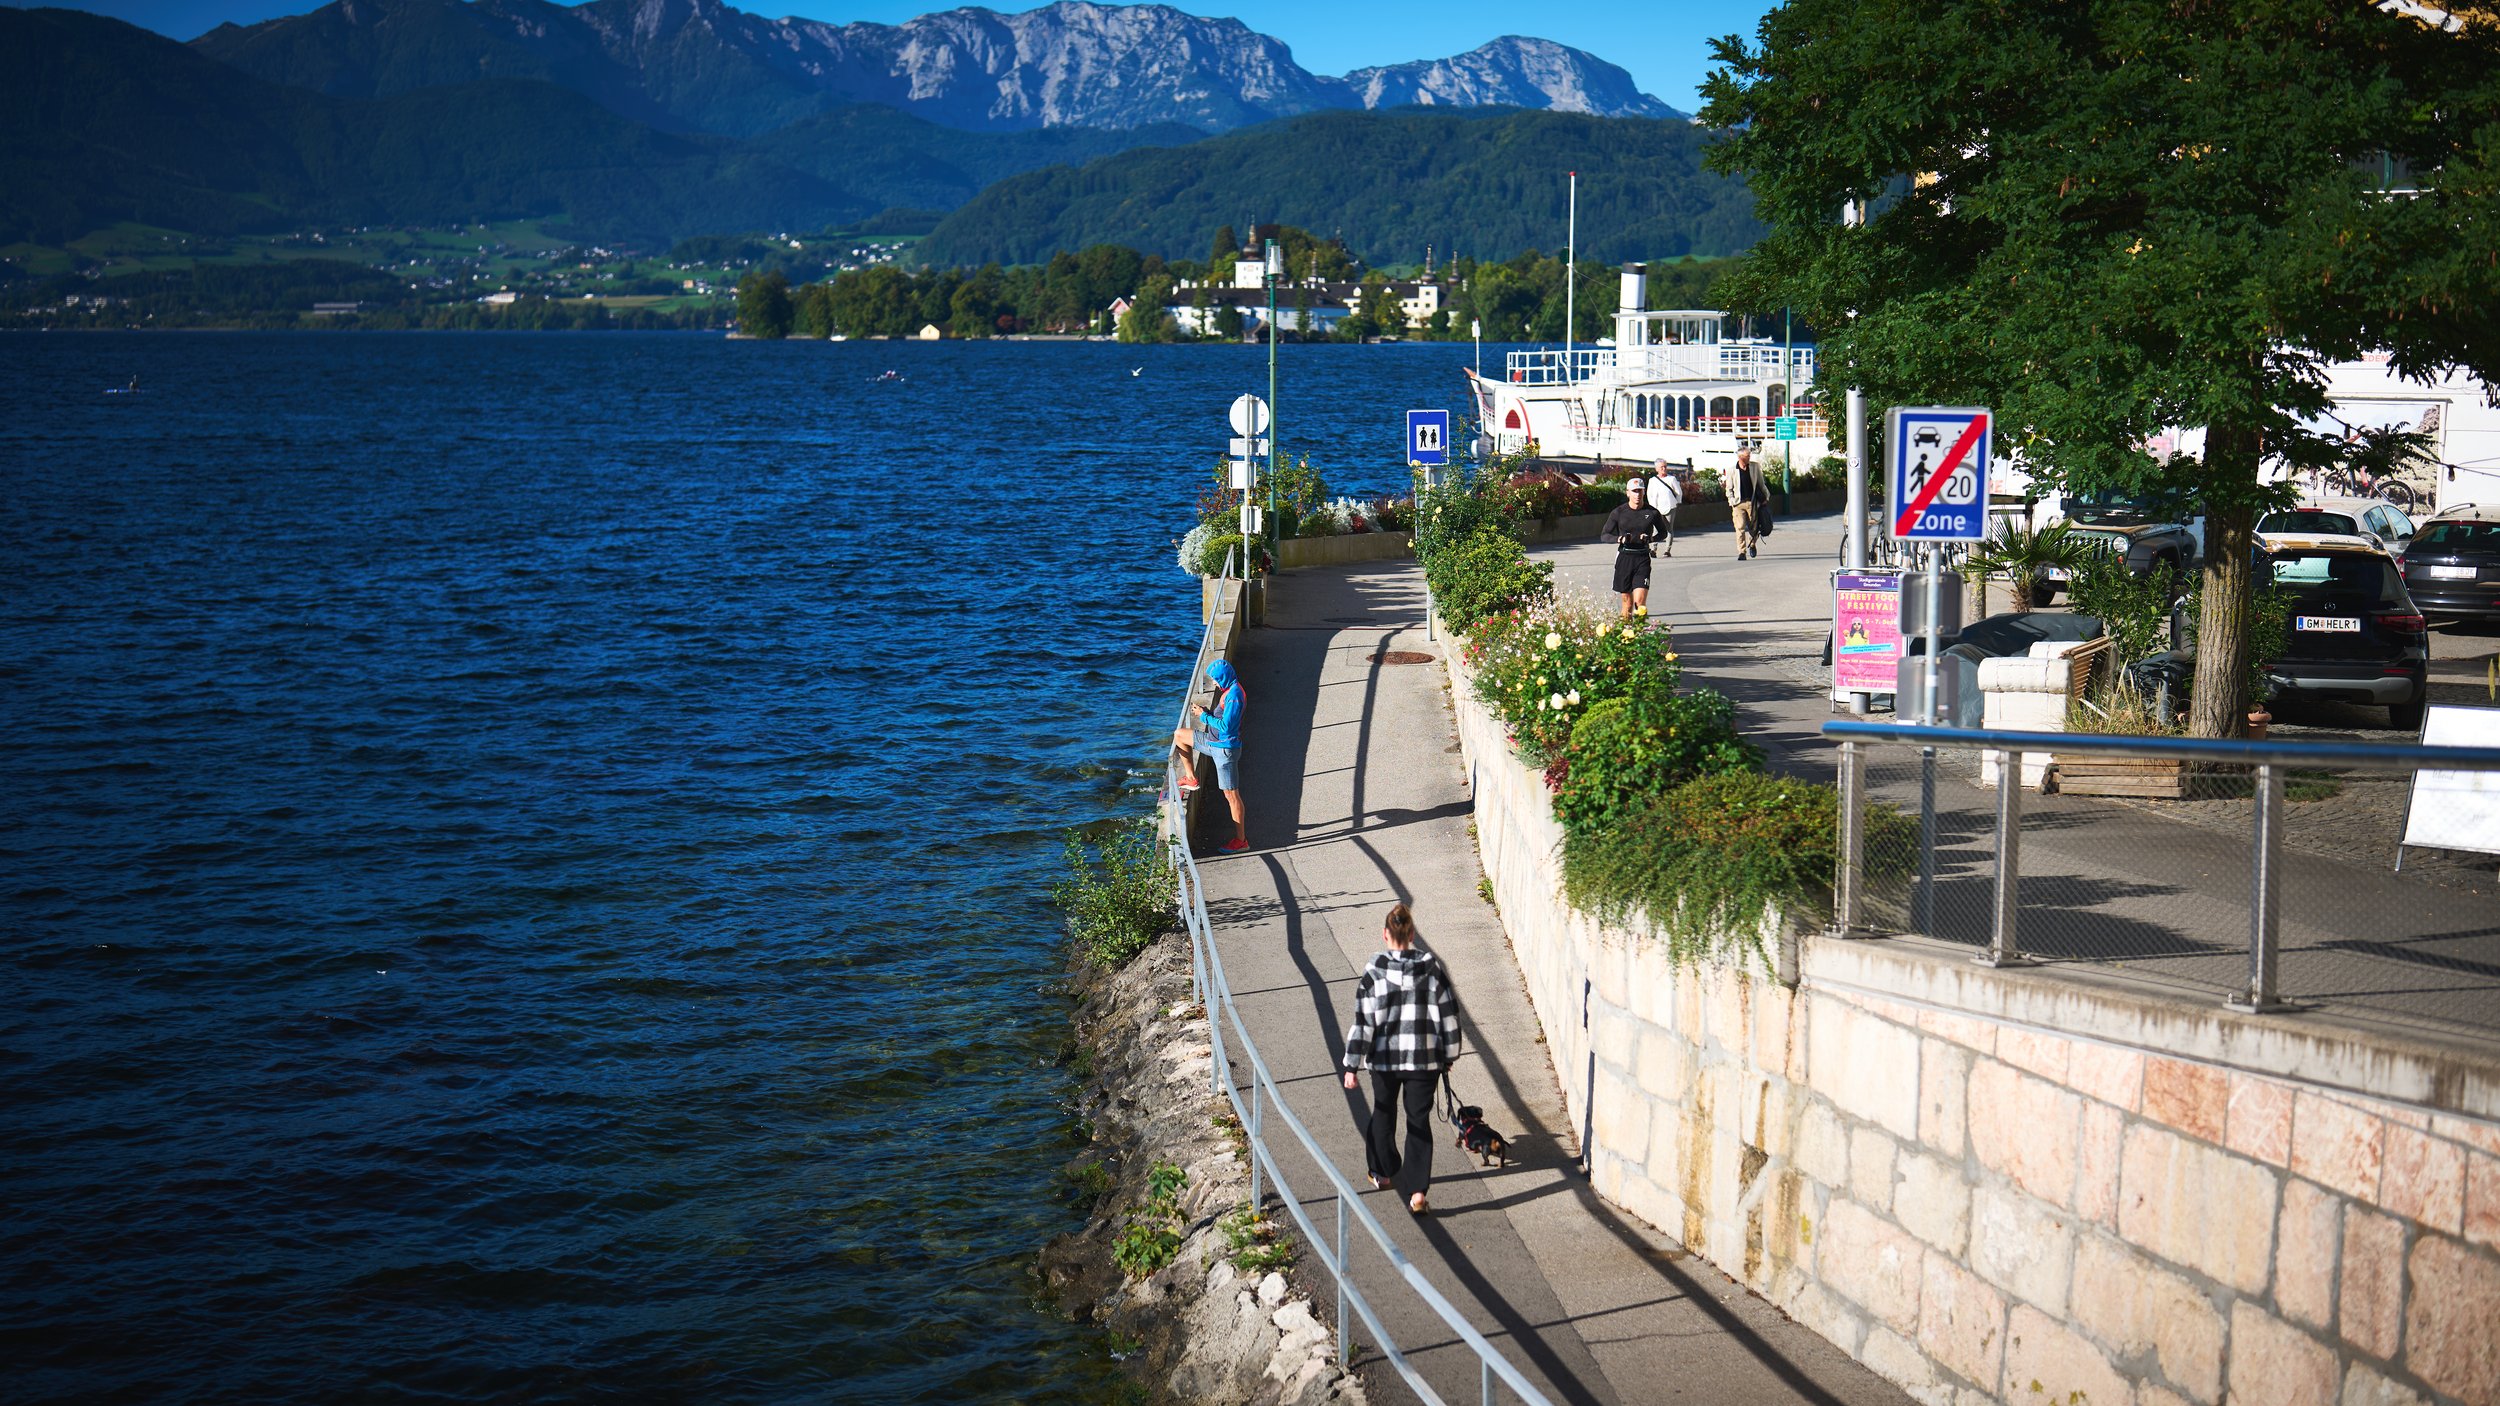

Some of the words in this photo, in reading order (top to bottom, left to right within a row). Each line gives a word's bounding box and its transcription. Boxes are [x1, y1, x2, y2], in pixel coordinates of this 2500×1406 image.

[1947, 475, 1971, 498] 20
[1912, 509, 1966, 531] Zone
[1847, 601, 1894, 610] FESTIVAL
[2306, 619, 2320, 629] GM
[2326, 619, 2350, 629] HELR
